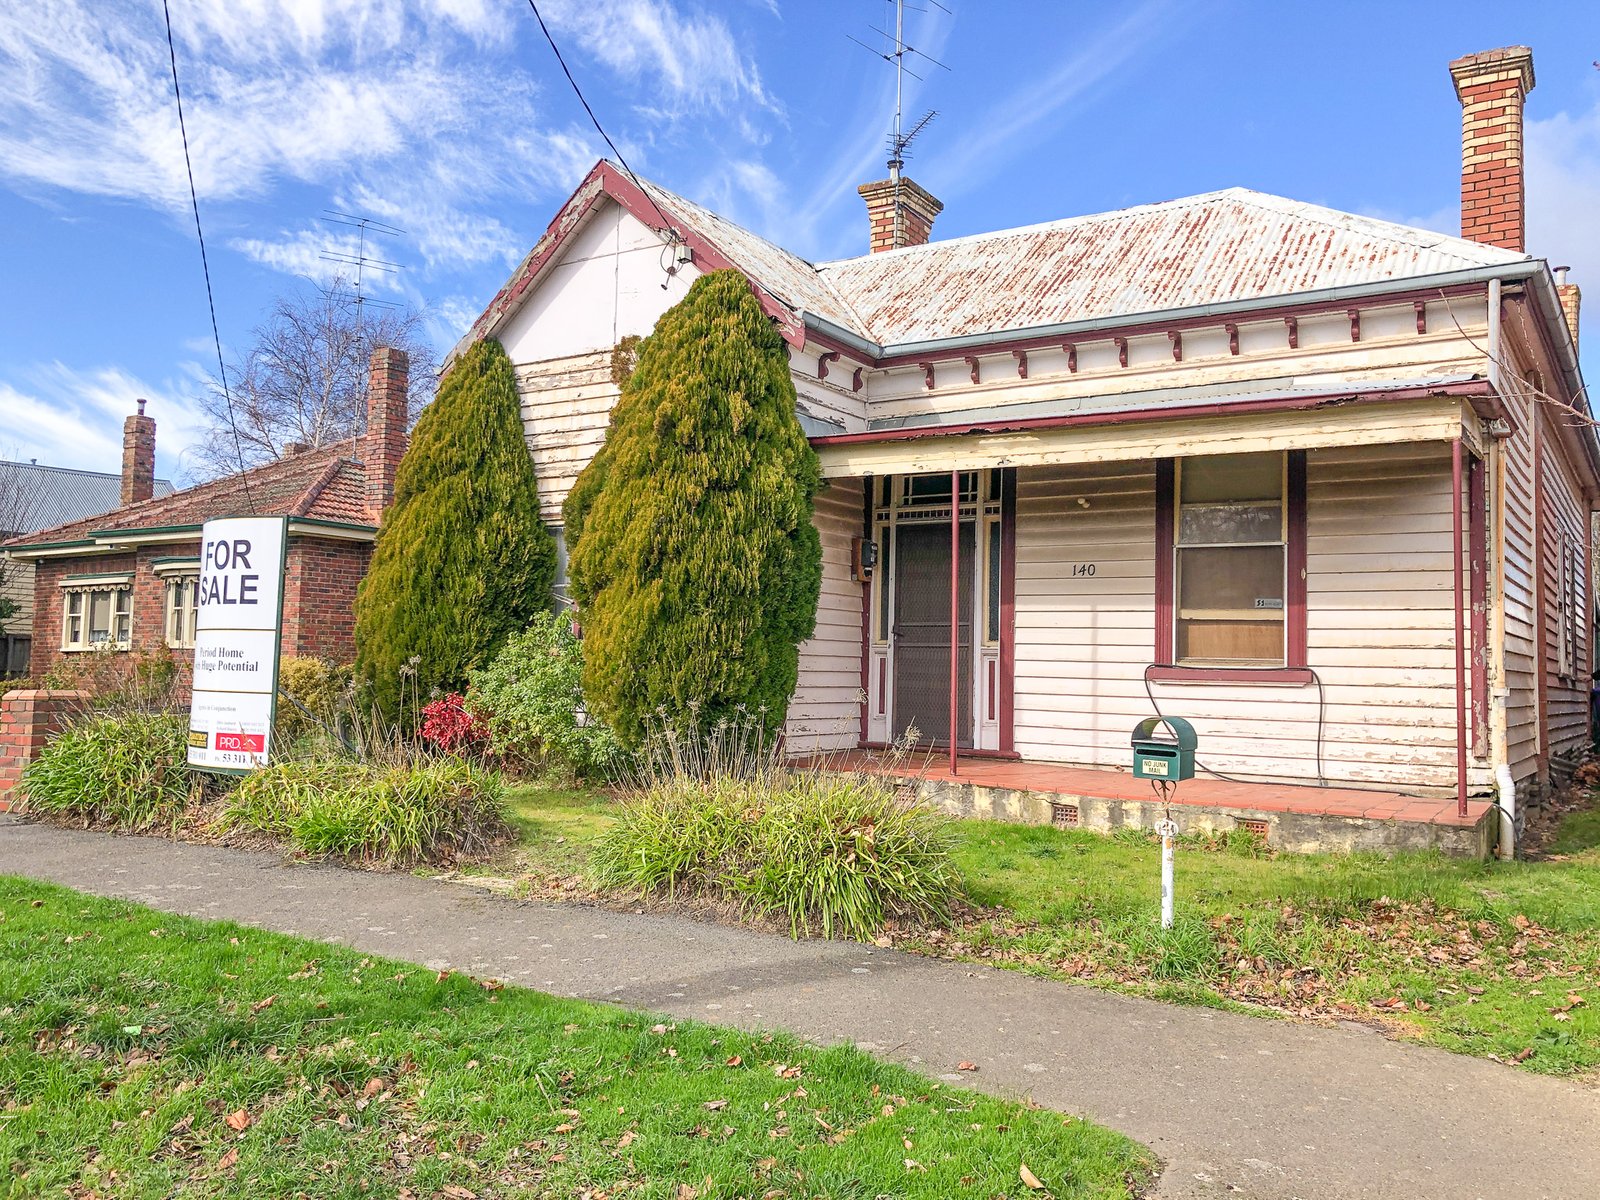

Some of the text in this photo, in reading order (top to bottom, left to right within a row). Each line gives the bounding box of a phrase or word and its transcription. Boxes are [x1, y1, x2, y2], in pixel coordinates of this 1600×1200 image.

[205, 539, 252, 571] FOR
[1072, 563, 1096, 577] 140
[200, 574, 259, 606] SALE
[199, 647, 244, 658] Period Home
[201, 660, 216, 673] Huge
[217, 660, 259, 672] Potential
